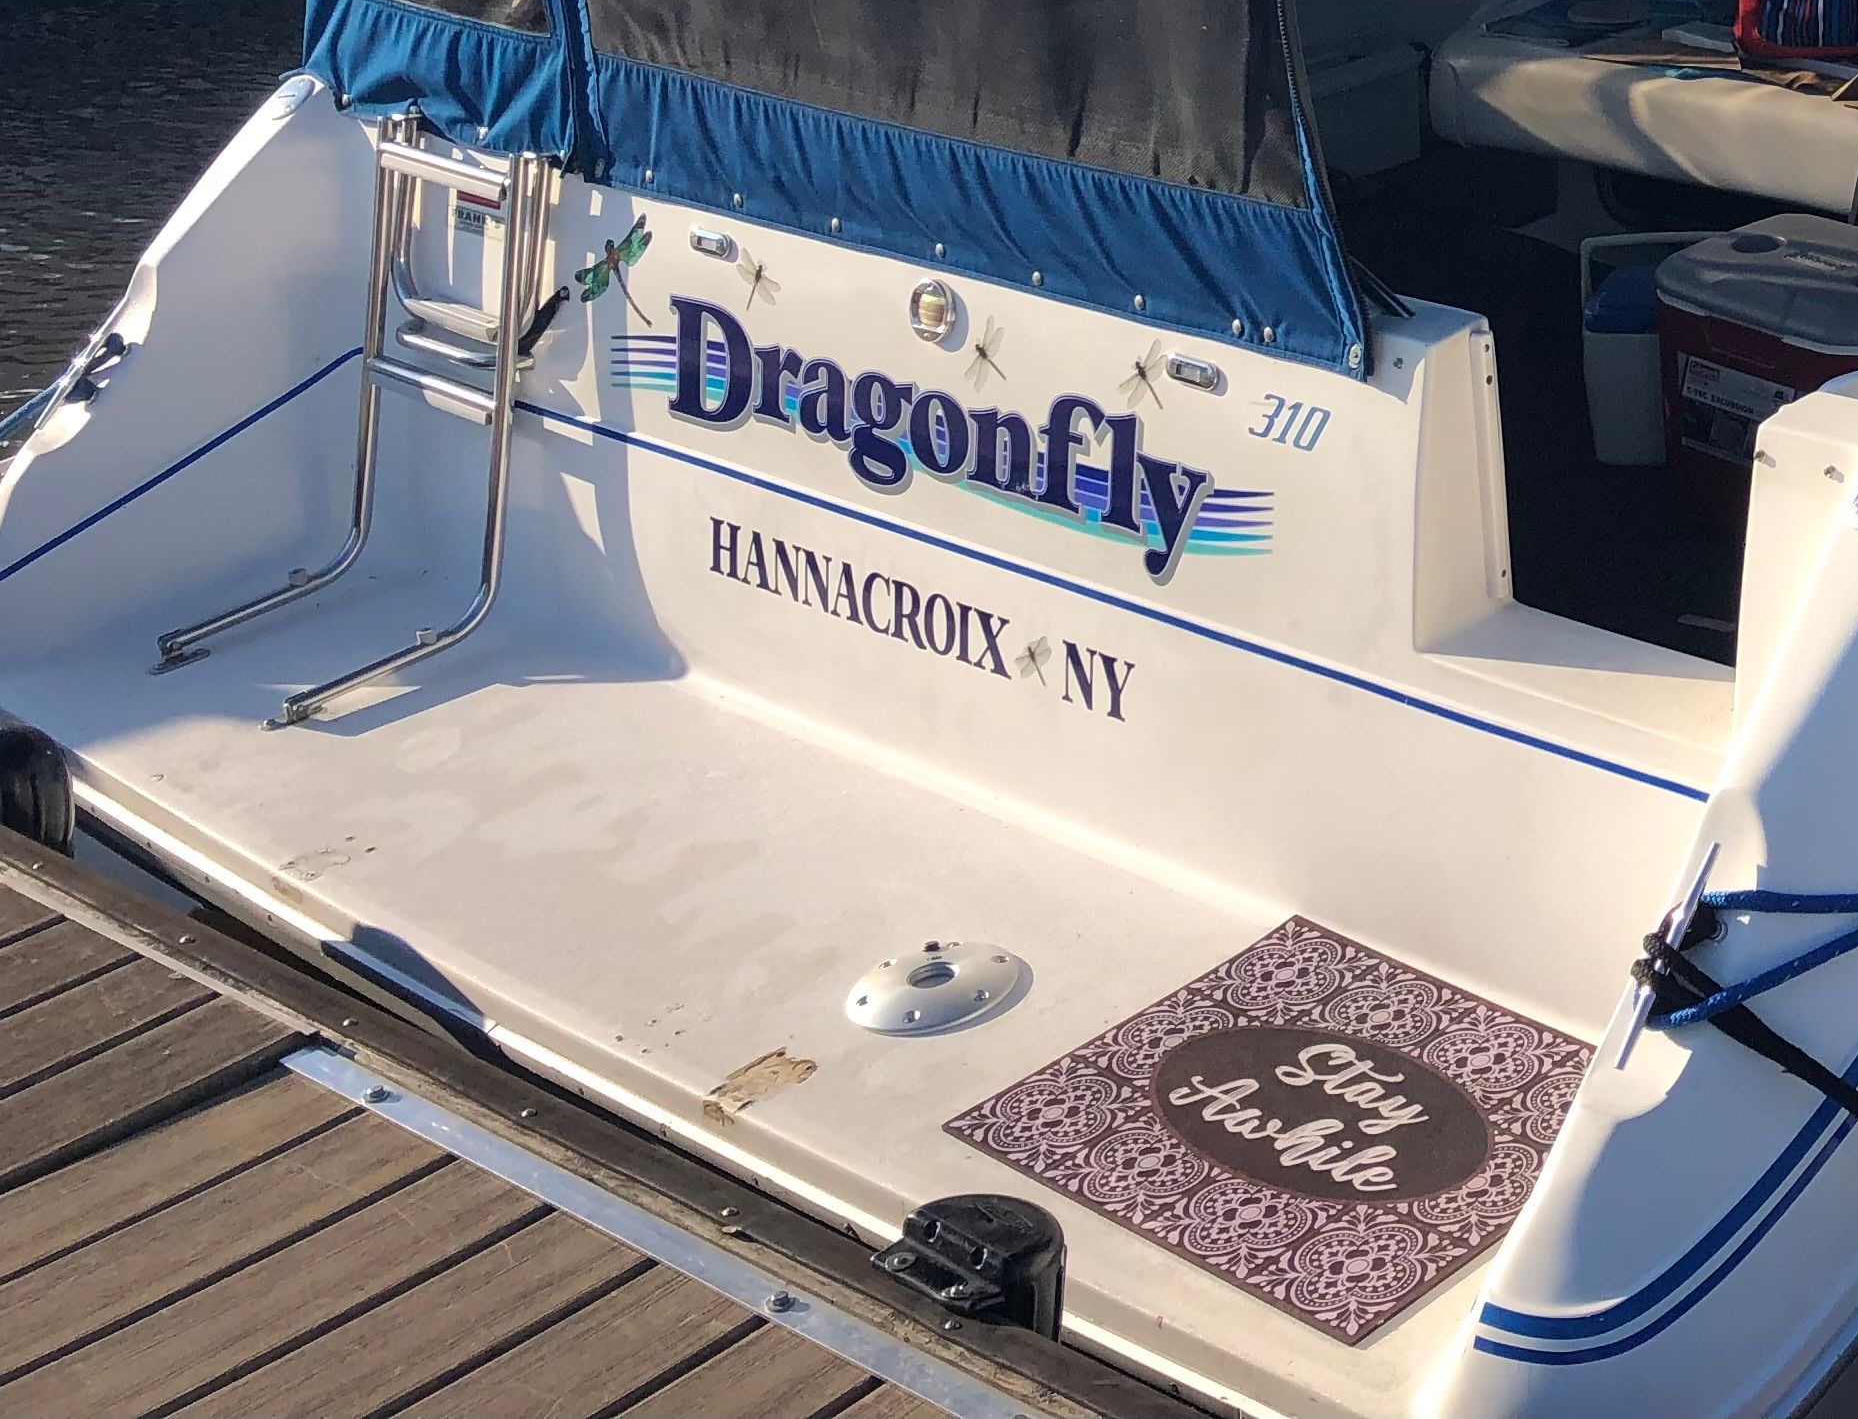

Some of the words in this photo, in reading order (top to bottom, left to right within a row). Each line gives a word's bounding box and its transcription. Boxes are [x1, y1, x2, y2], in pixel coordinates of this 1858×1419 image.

[669, 294, 1210, 580] Dragonfly
[1248, 393, 1331, 452] 310
[709, 516, 1011, 680] HANNACROIX
[1061, 639, 1136, 723] NY
[1169, 1073, 1397, 1192] Awhile
[1275, 1042, 1429, 1133] Stay
